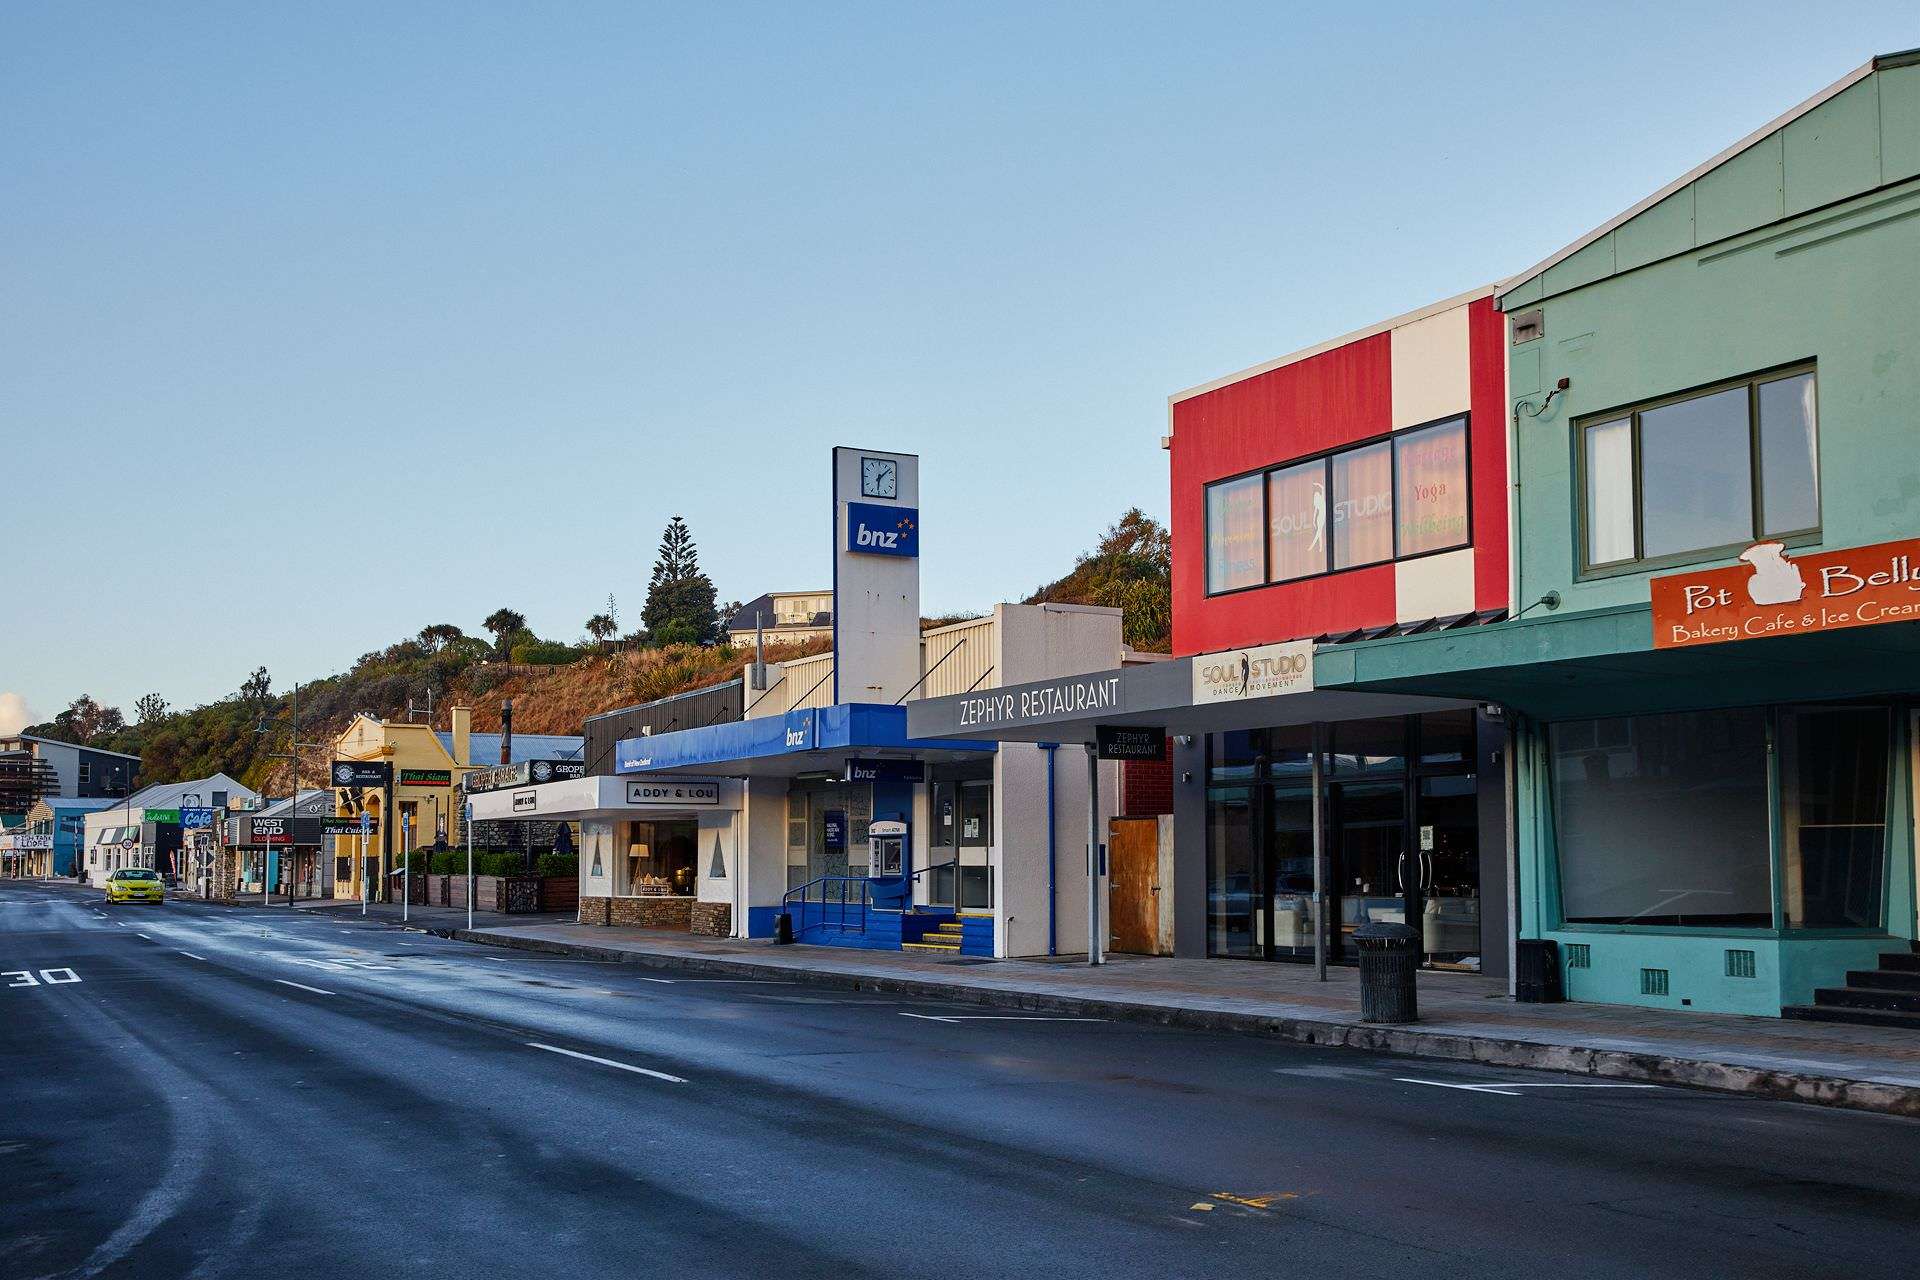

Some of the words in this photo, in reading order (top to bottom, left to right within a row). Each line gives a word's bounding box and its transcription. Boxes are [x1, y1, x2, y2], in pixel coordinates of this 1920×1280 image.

[1414, 483, 1447, 504] Yoga
[1271, 512, 1313, 537] SOUL
[856, 523, 899, 549] bnz
[1683, 585, 1733, 615] Pot
[1672, 622, 1738, 641] Bakery
[1744, 613, 1795, 636] Cafe
[1801, 614, 1815, 627] &
[1822, 608, 1850, 627] Ice
[1203, 664, 1239, 685] SOUL
[1251, 654, 1307, 679] STUDIO
[1213, 687, 1239, 696] DANCE
[1250, 680, 1295, 691] MOVEMENT
[960, 694, 1014, 726] ZEPHYR
[1021, 678, 1120, 718] RESTAURANT
[786, 727, 804, 747] bnz
[1117, 732, 1151, 744] ZEPHYR
[1108, 743, 1157, 755] RESTAURANT
[854, 766, 876, 779] bnz
[634, 788, 669, 798] ADDY
[675, 788, 682, 798] &
[689, 788, 714, 798] LOU
[253, 818, 285, 827] WEST
[253, 827, 284, 835] END
[345, 826, 374, 834] Cuise
[0, 967, 83, 988] 30
